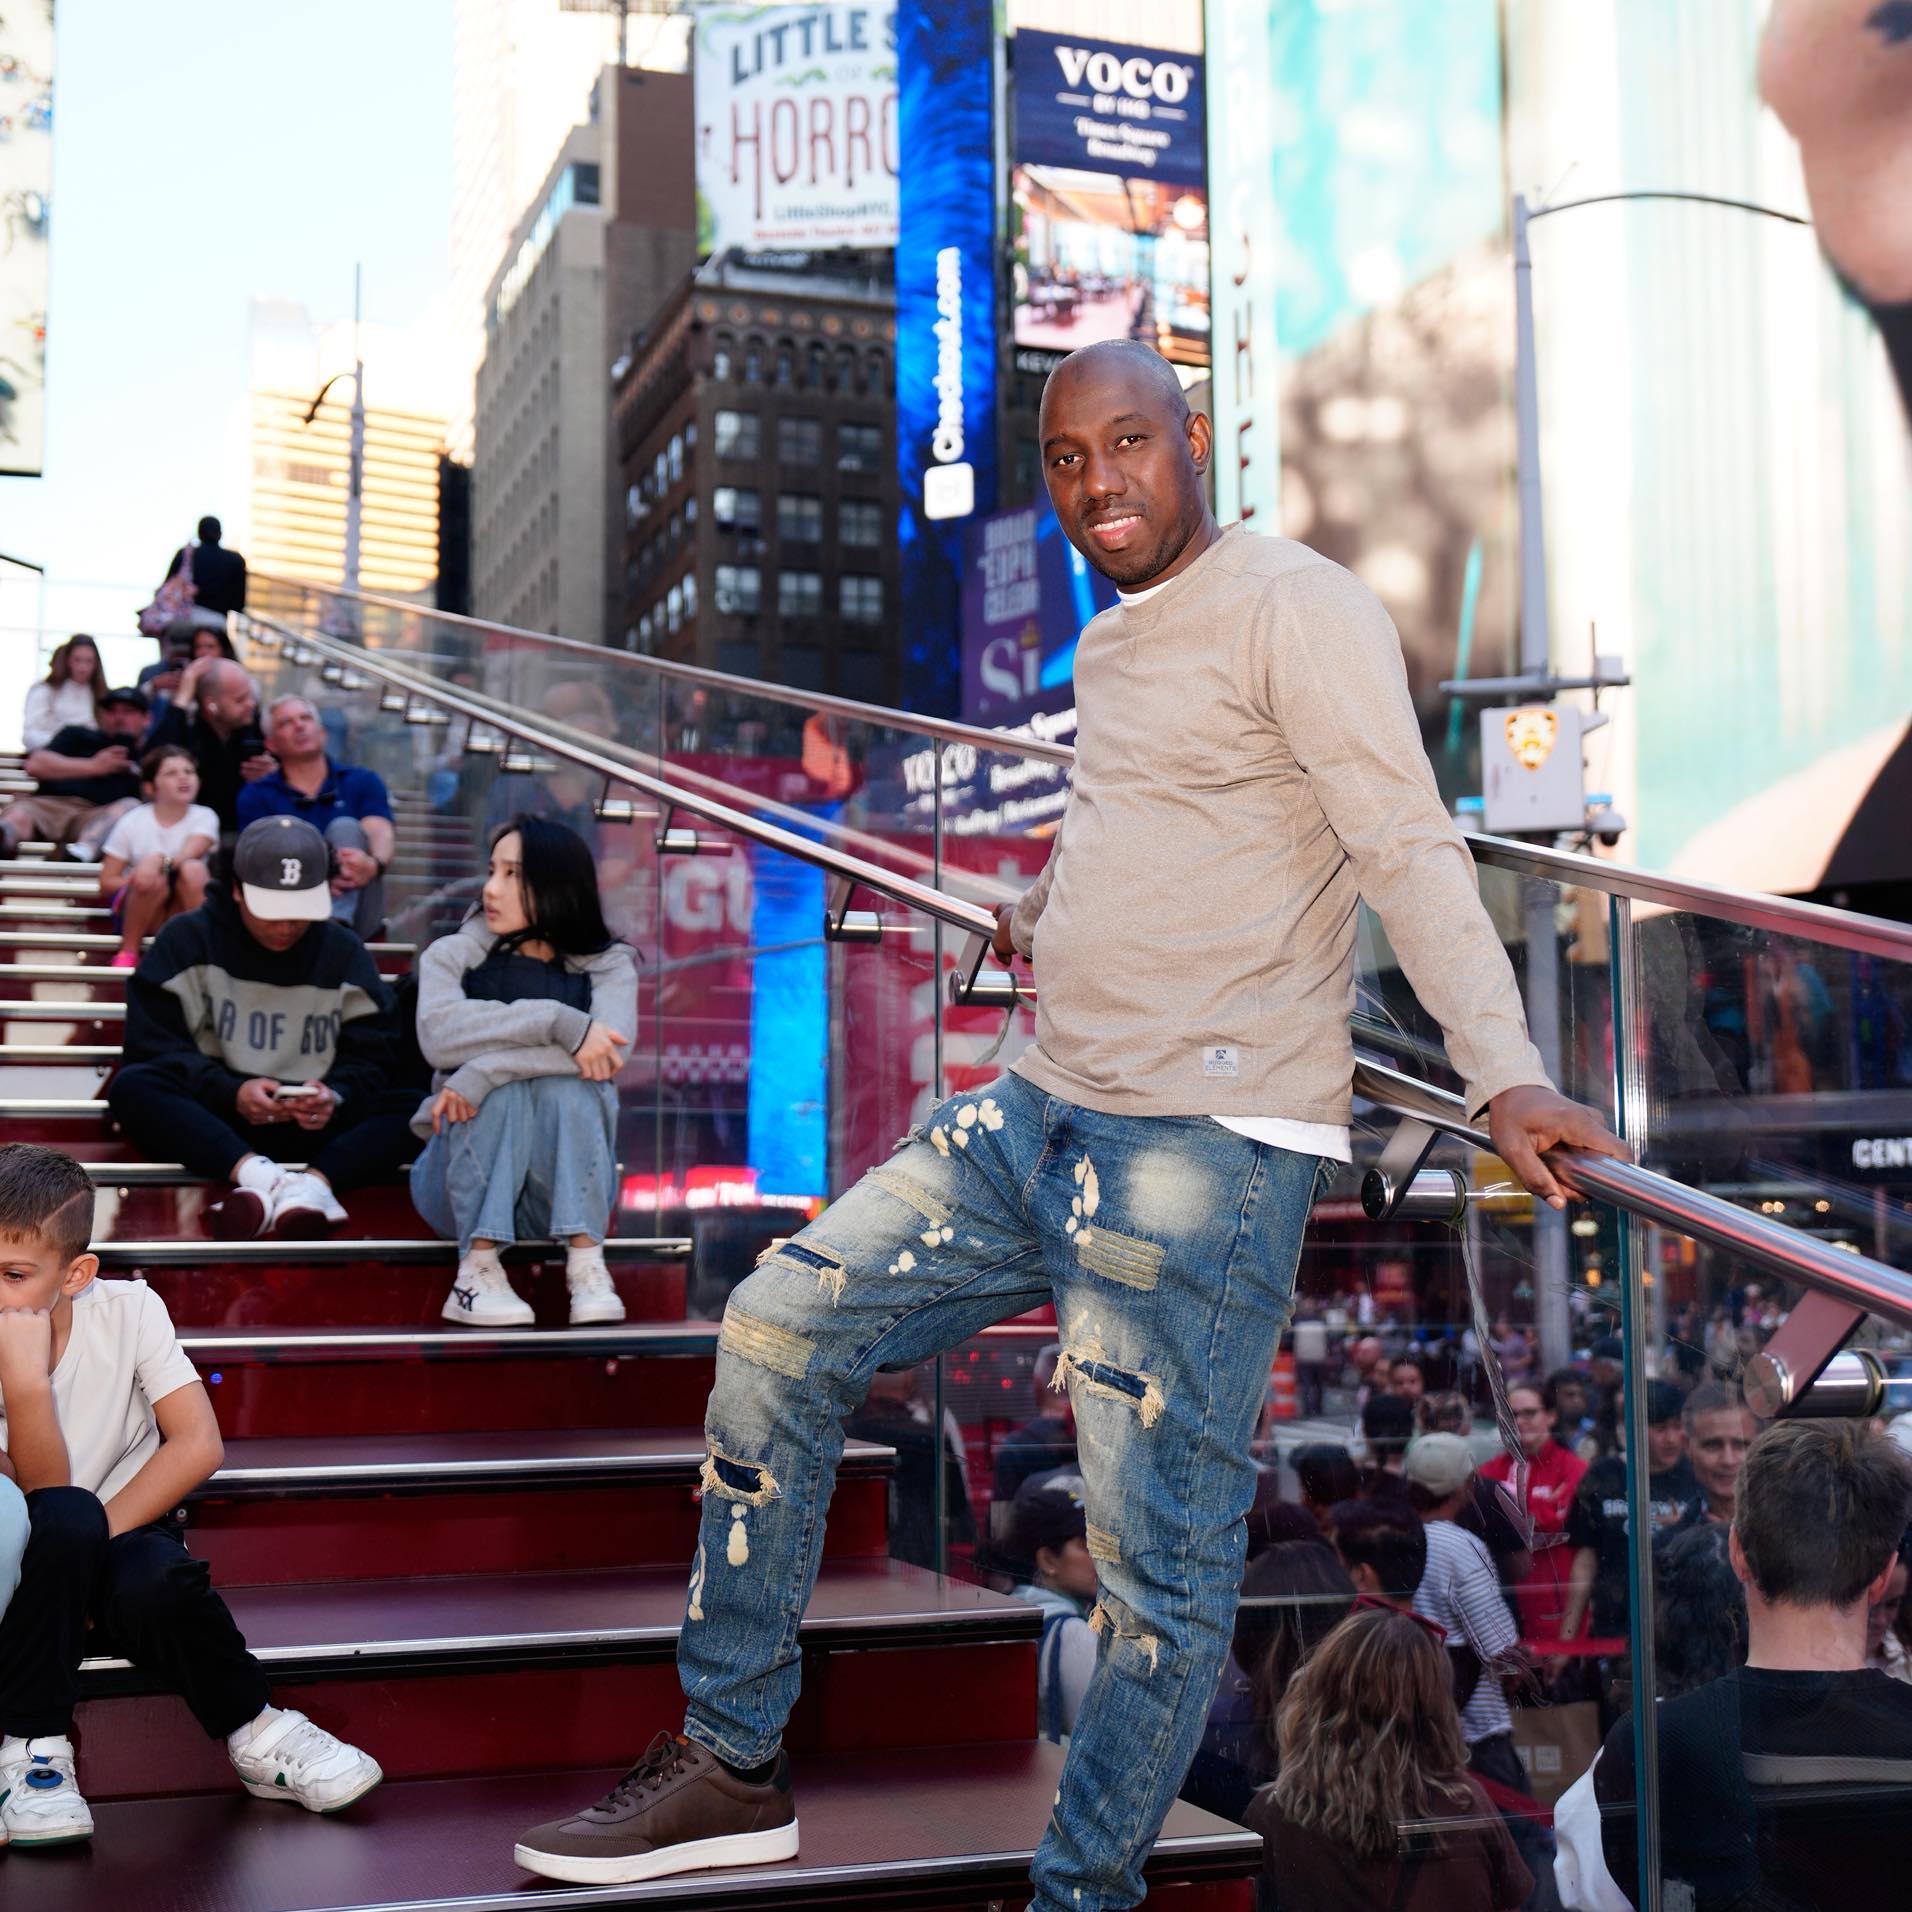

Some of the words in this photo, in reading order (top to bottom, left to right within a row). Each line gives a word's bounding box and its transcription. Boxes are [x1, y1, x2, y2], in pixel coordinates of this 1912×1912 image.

[732, 11, 868, 85] LITTLE
[280, 858, 301, 886] B
[249, 1010, 286, 1050] OF
